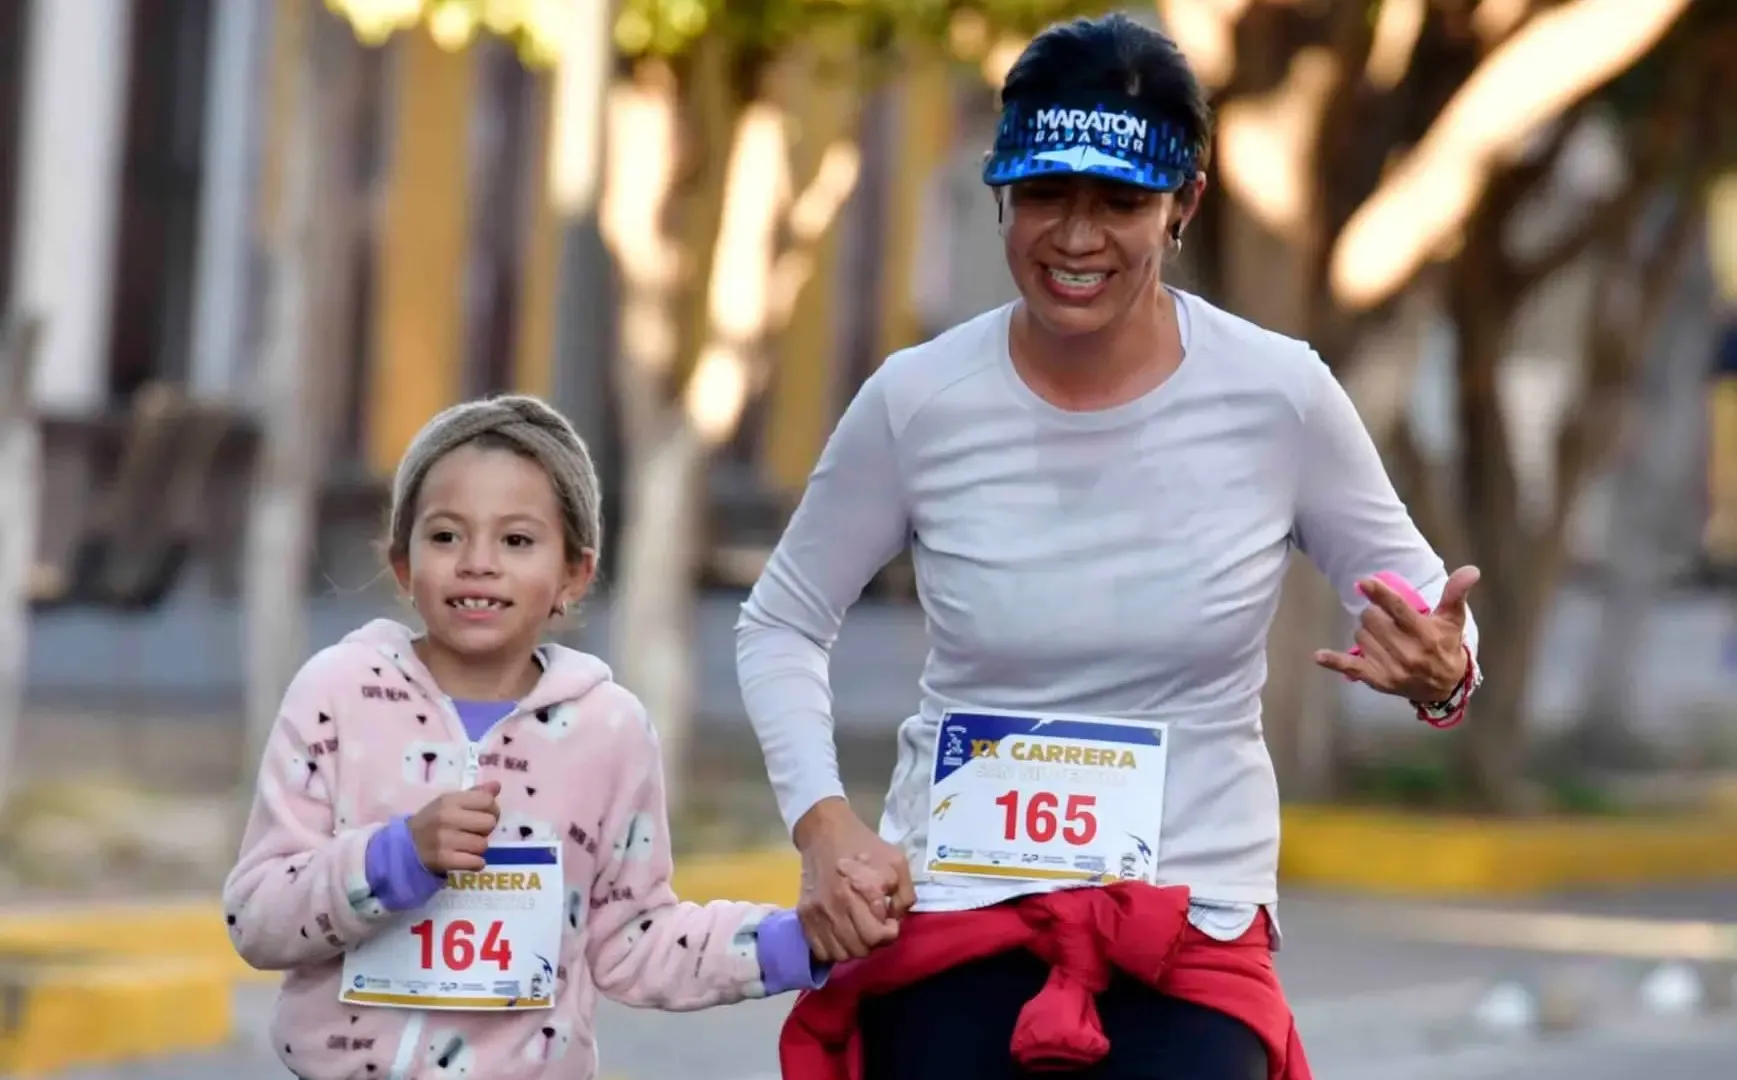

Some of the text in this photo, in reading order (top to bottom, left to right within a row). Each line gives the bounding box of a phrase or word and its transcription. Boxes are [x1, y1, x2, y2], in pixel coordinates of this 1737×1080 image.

[1036, 109, 1148, 139] MARATÓN
[1034, 130, 1144, 153] BAJA SUR
[970, 739, 1137, 769] XX CARRERA
[995, 789, 1098, 847] 165
[447, 872, 542, 891] ARRERA
[410, 919, 513, 971] 164
